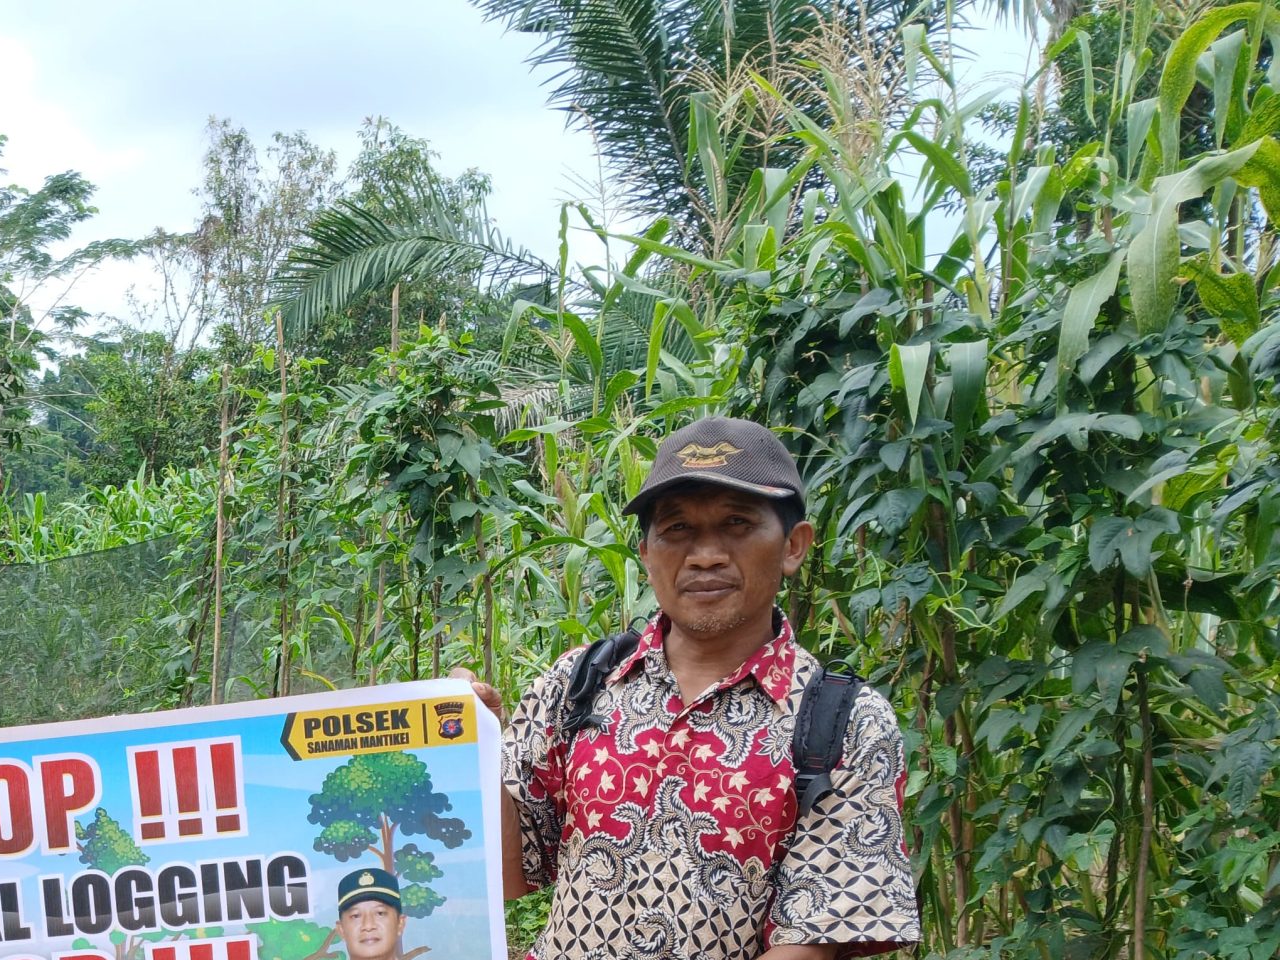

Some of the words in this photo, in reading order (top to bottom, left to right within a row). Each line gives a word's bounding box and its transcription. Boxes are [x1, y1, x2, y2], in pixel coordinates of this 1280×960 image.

[303, 708, 411, 739] POLSEK
[307, 739, 358, 754] SANAMAN
[360, 732, 410, 748] MANTIKEI
[134, 743, 238, 840] !!!
[43, 855, 309, 937] LOGGING
